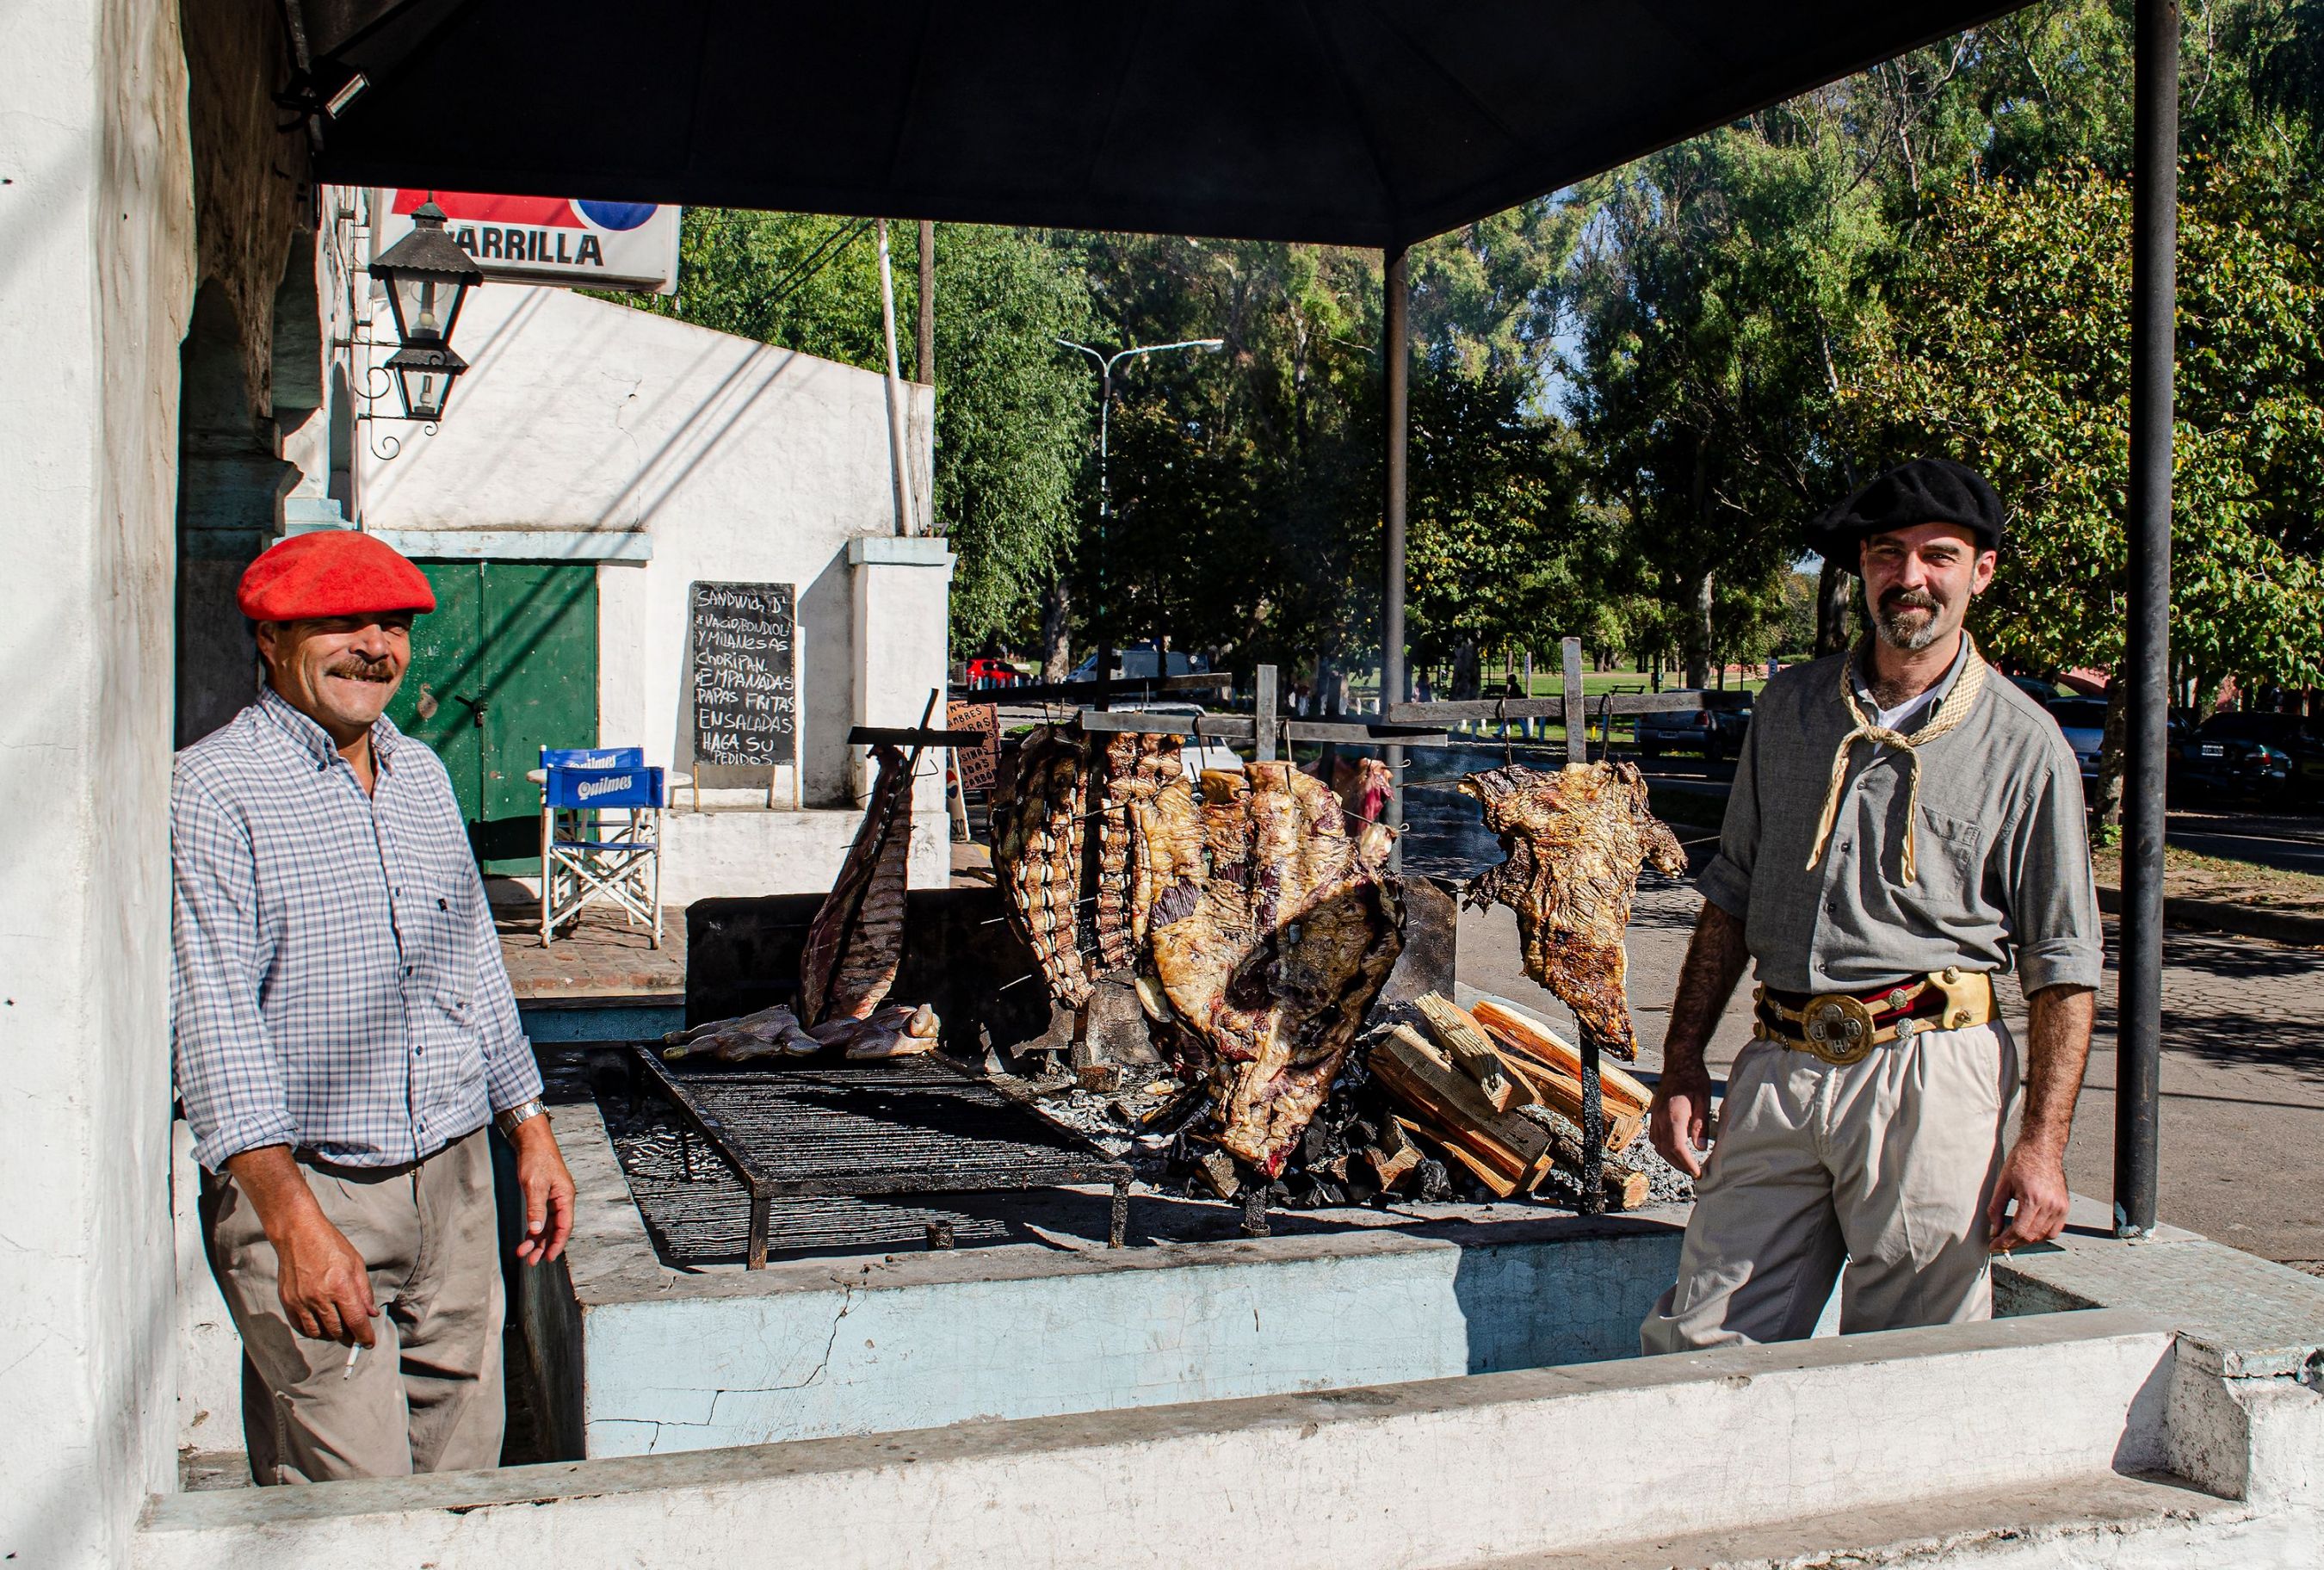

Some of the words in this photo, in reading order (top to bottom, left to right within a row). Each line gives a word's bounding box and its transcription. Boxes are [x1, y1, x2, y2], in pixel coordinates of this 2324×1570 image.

[448, 226, 604, 267] ARRILLA
[695, 687, 739, 705] PAPAS
[699, 708, 793, 734] ENSALADAS
[946, 707, 983, 728] AMBRES
[702, 732, 740, 753] HAGA
[745, 736, 774, 753] SU
[578, 775, 633, 800] Quilmes
